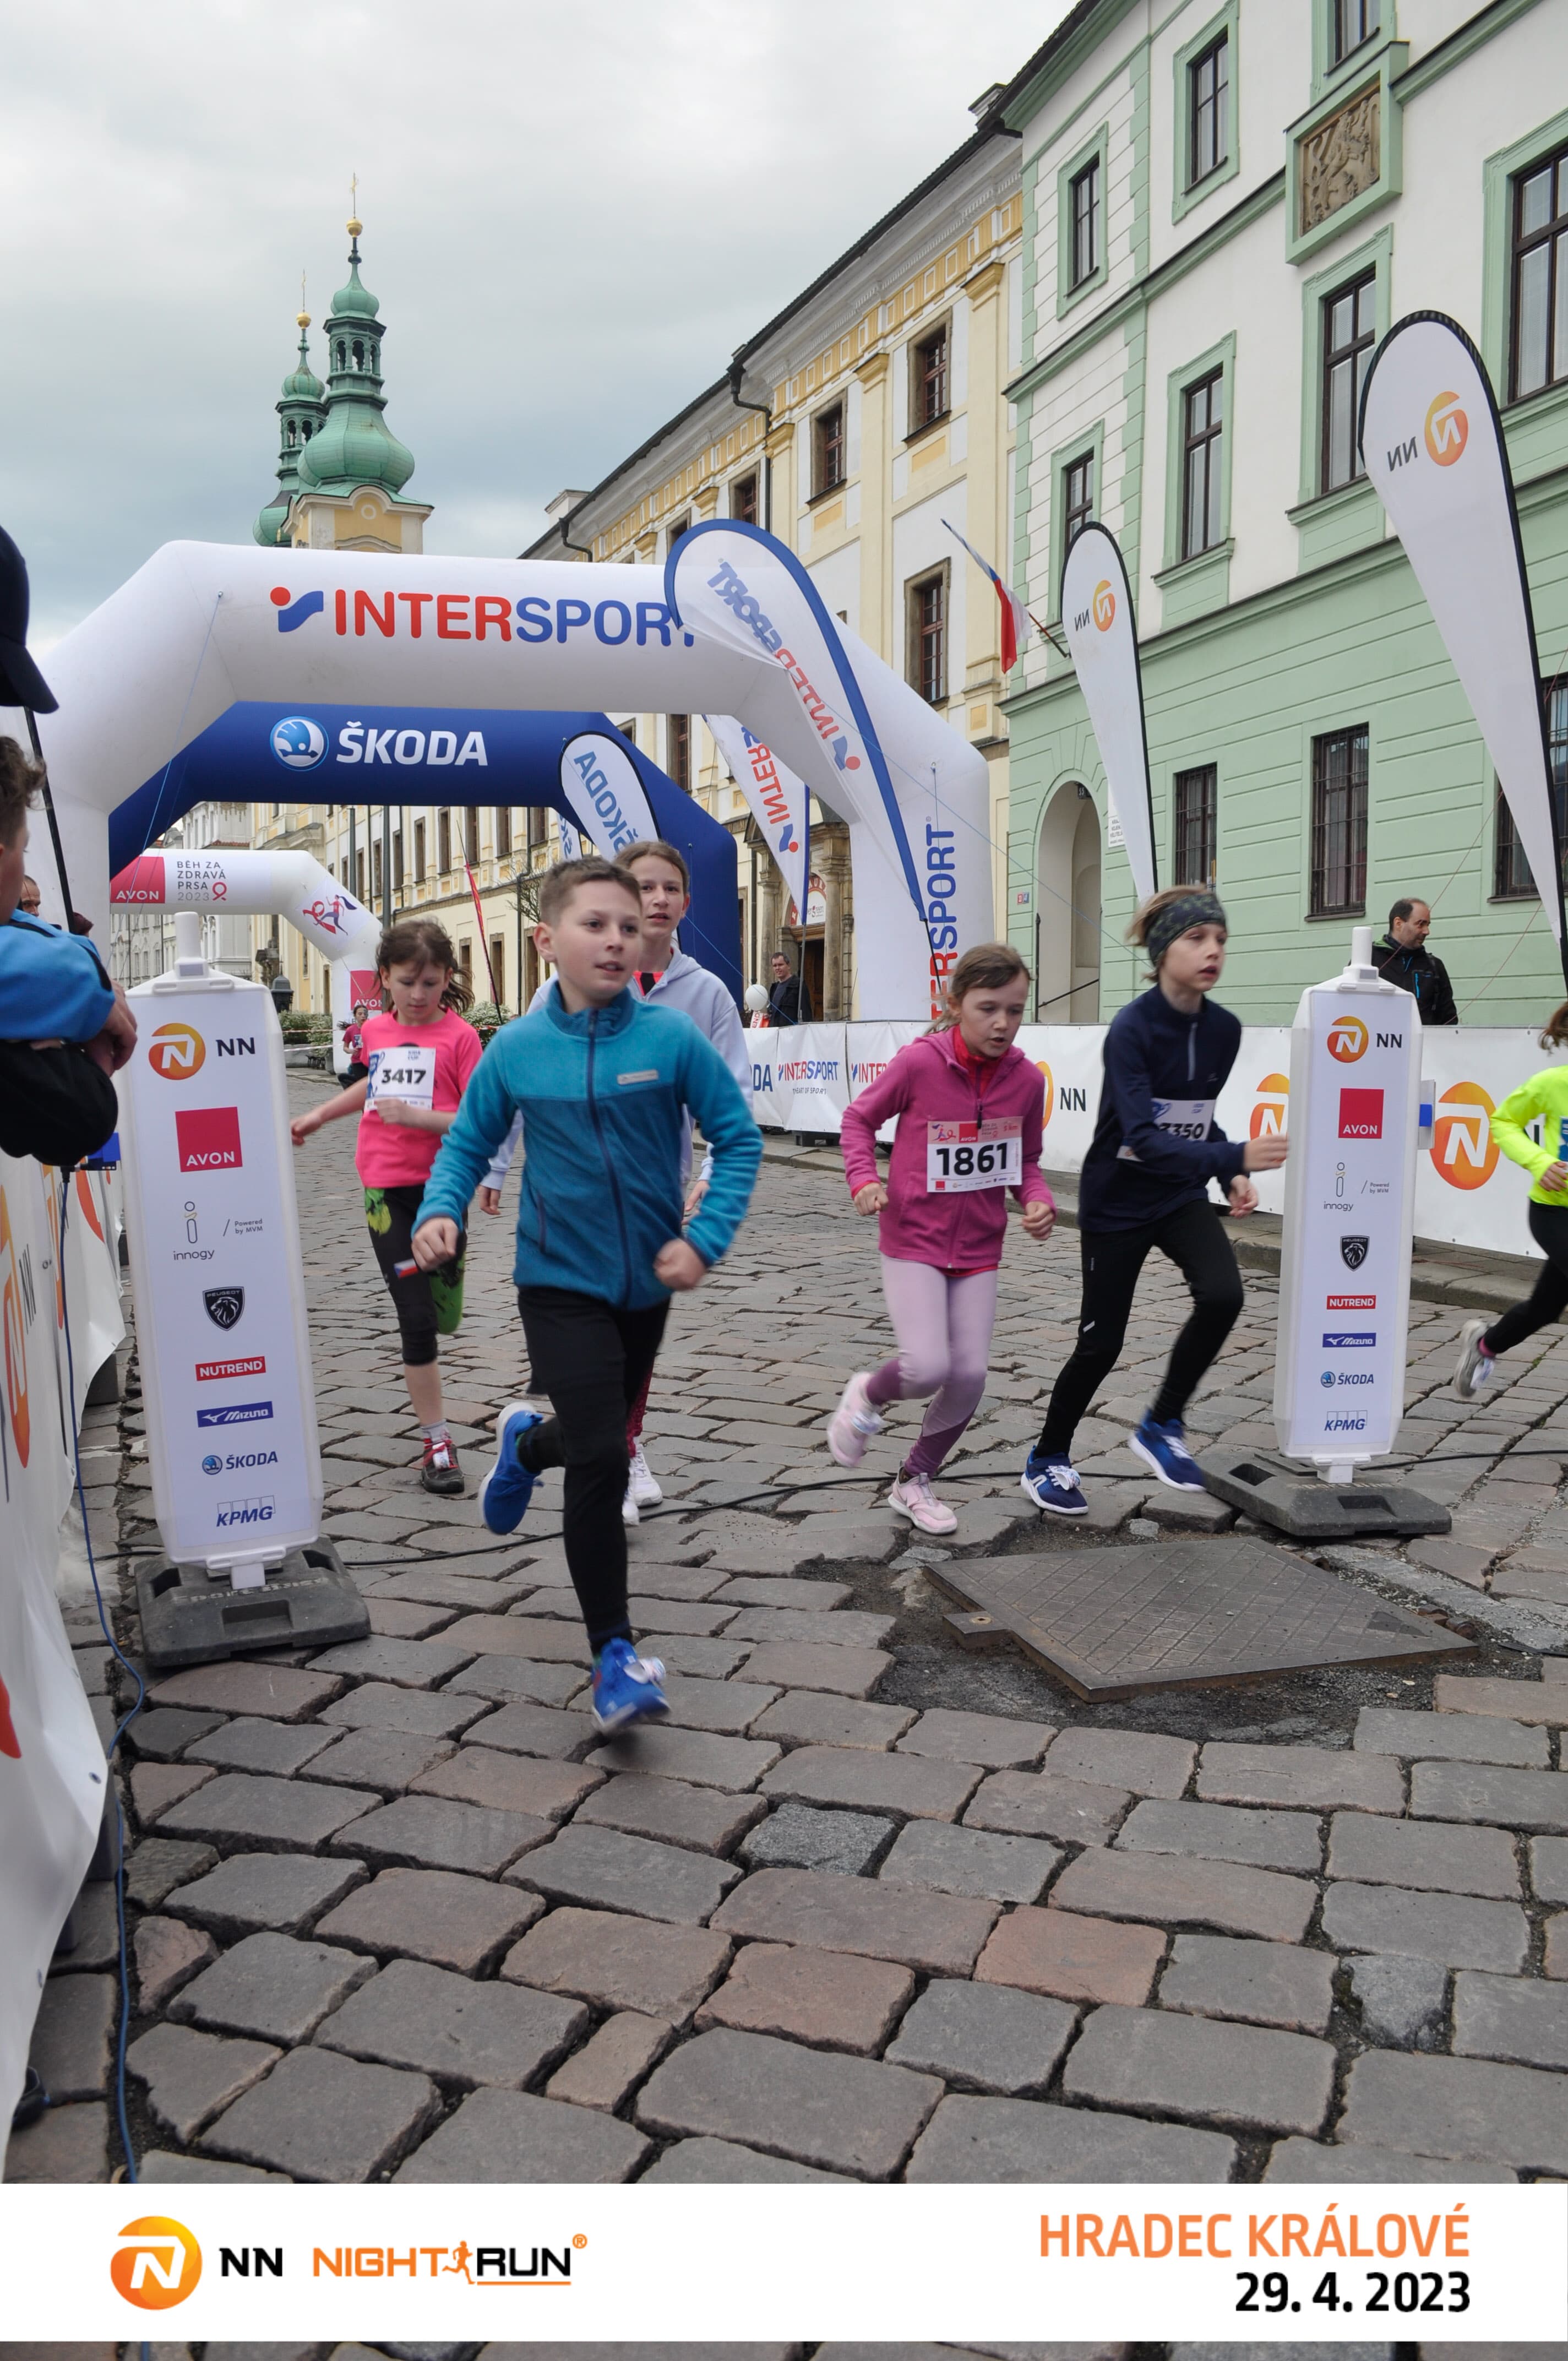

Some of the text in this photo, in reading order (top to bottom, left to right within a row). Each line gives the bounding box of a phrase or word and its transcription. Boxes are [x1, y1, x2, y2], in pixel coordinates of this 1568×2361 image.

[336, 721, 488, 766] ŠKODA
[177, 860, 200, 868] BĚH
[177, 869, 226, 879] ZDRAVÁ
[177, 882, 208, 890] PRSA
[116, 890, 159, 900] AVON
[177, 892, 209, 901] 2023
[1376, 1033, 1402, 1048] NN
[215, 1037, 255, 1057] NN
[382, 1069, 426, 1084] 3417
[1060, 1087, 1086, 1112] NN
[1343, 1124, 1378, 1134] AVON
[186, 1151, 235, 1166] AVON
[936, 1143, 1008, 1176] 1861
[1324, 1201, 1354, 1211] innogy
[235, 1218, 263, 1227] Powered
[173, 1249, 215, 1260] innogy
[1329, 1298, 1374, 1307] NUTREND
[199, 1361, 263, 1377] NUTREND
[1337, 1372, 1374, 1385] ŠKODA
[1324, 1419, 1366, 1431] KPMG
[226, 1451, 278, 1470] ŠKODA
[216, 1506, 273, 1527] KPMG
